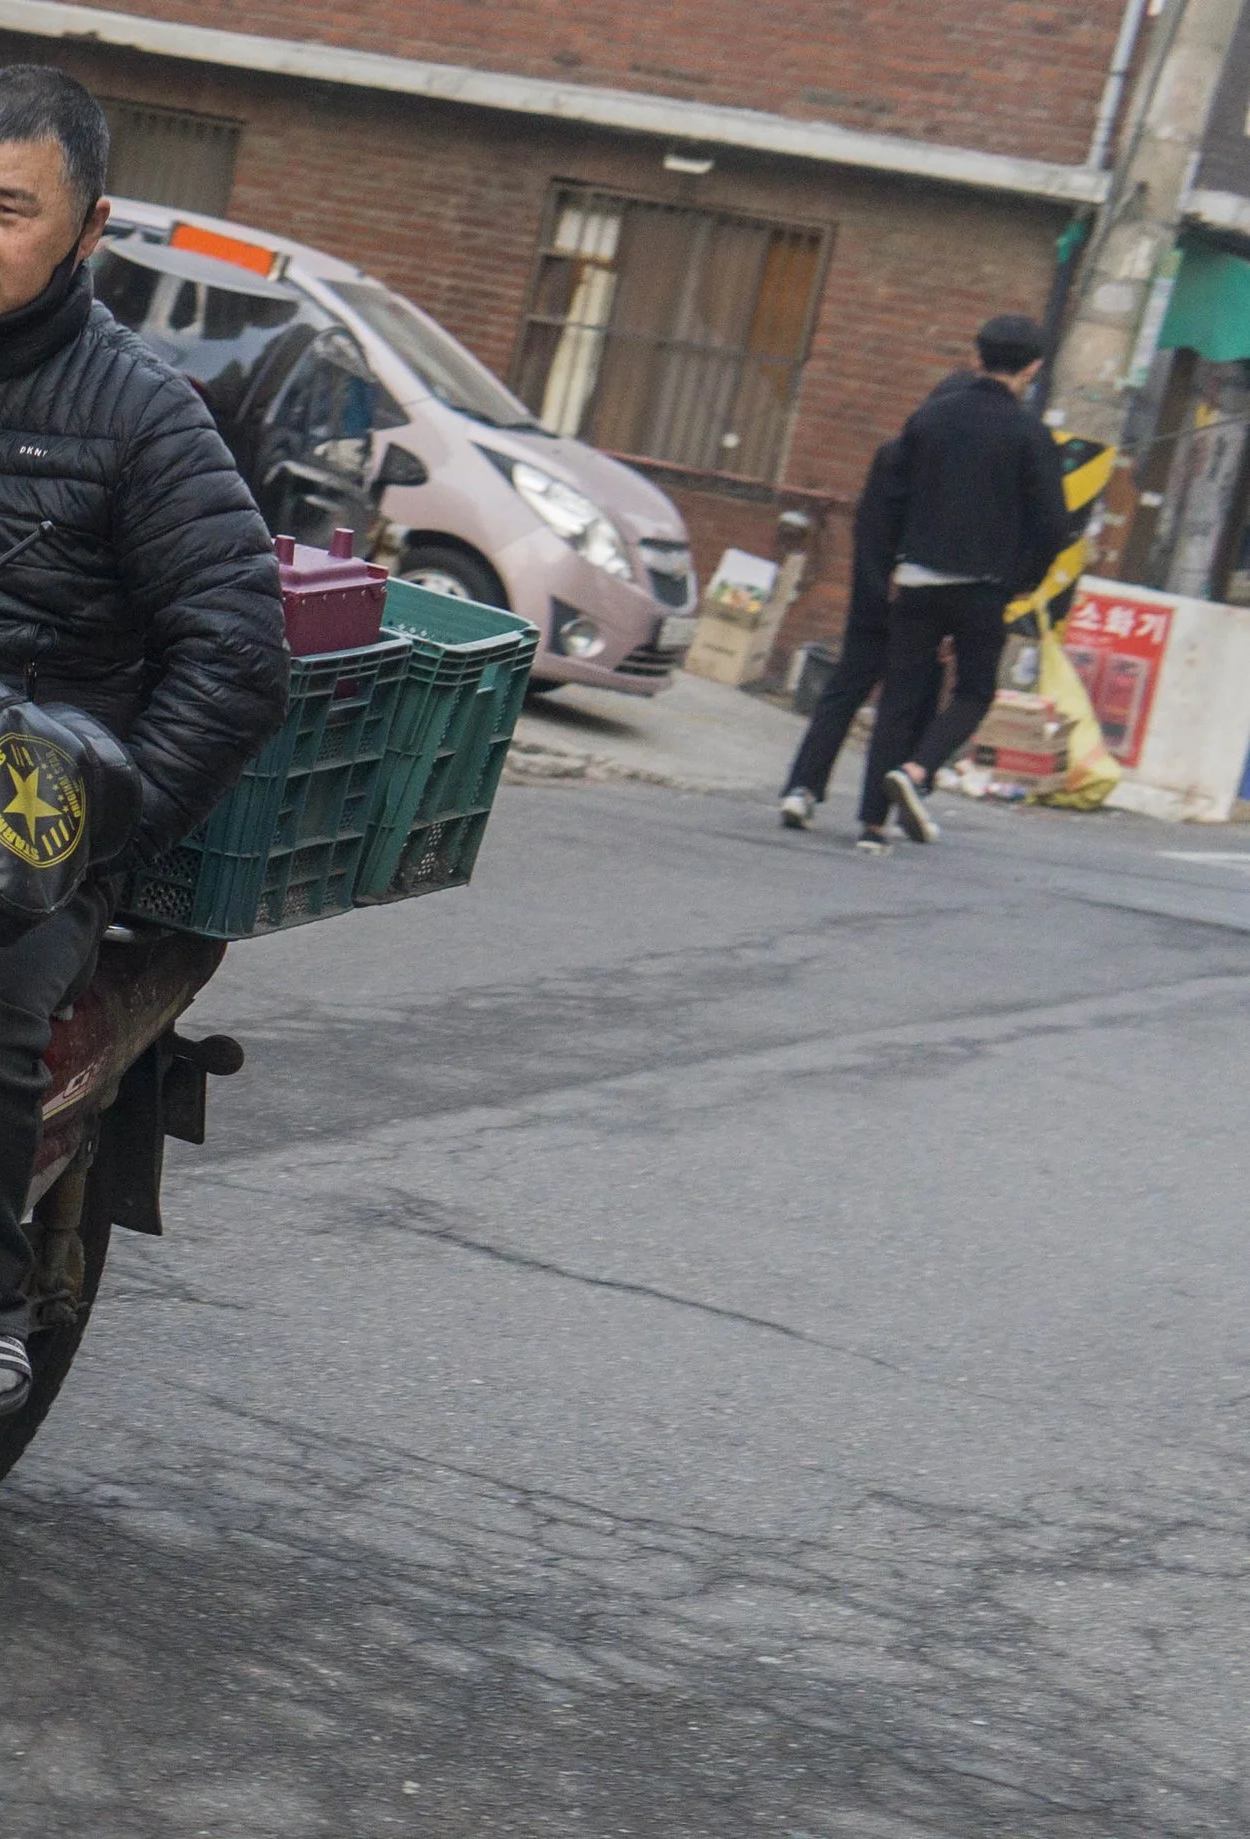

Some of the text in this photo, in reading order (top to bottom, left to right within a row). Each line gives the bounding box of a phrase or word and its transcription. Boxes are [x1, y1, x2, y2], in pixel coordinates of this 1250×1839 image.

[19, 445, 49, 457] DKNY
[1069, 602, 1168, 645] 소화기
[45, 750, 64, 775] STAR
[54, 775, 82, 818] ORIGINAL
